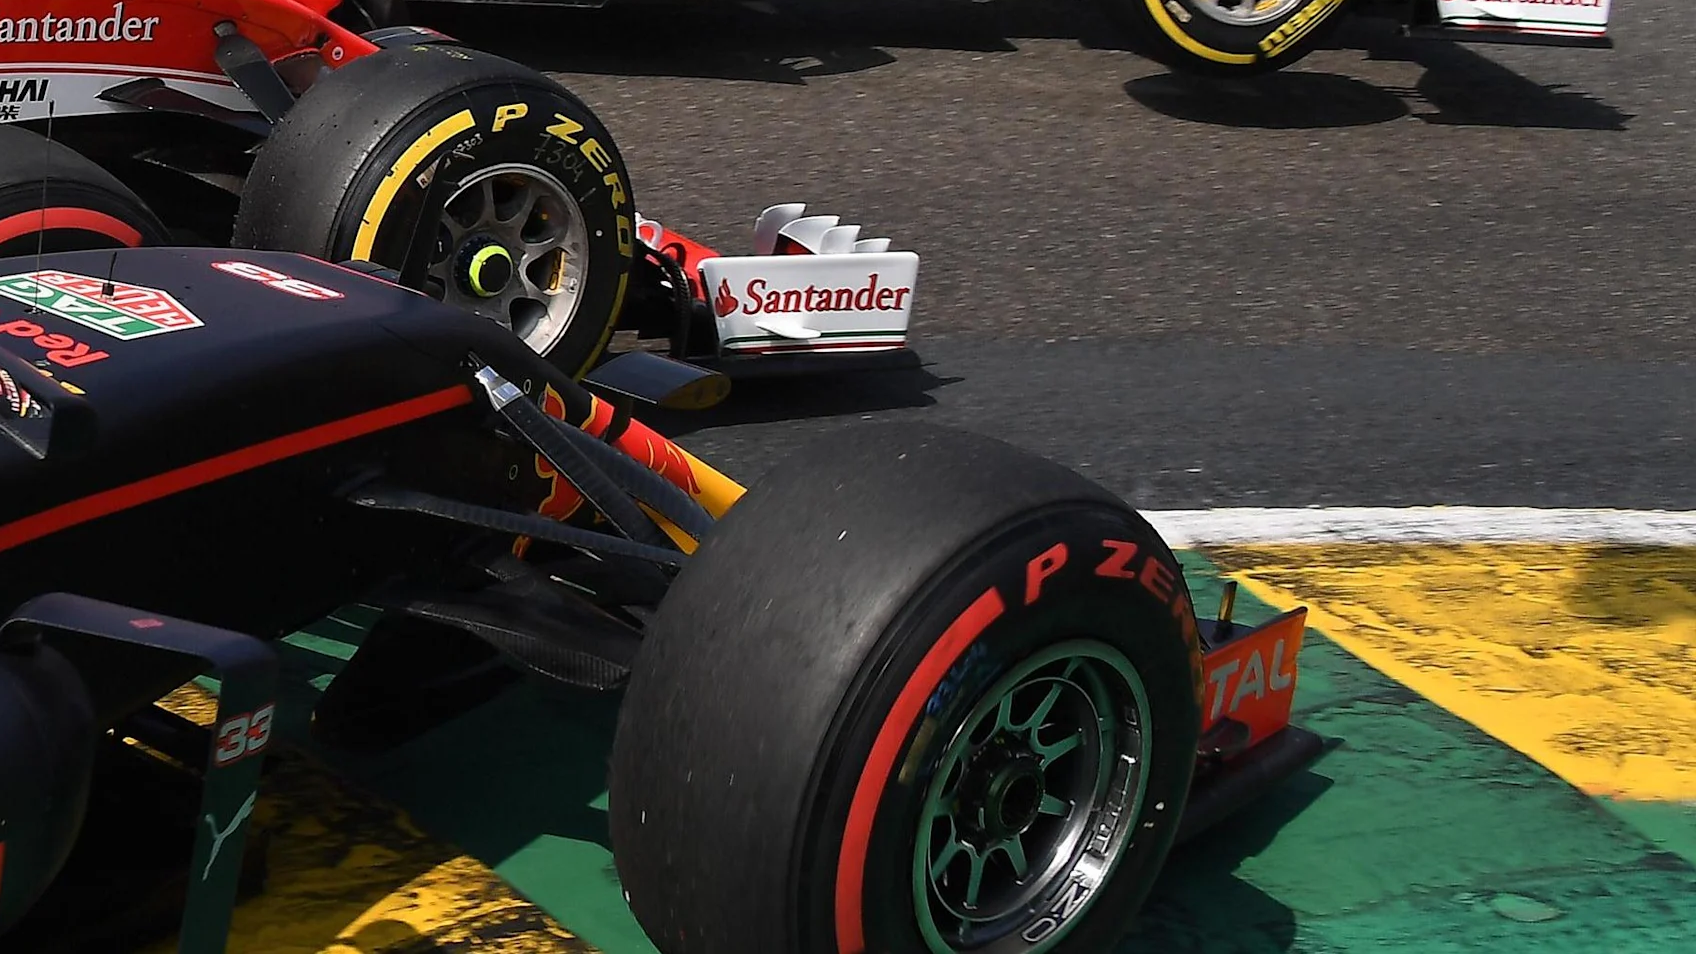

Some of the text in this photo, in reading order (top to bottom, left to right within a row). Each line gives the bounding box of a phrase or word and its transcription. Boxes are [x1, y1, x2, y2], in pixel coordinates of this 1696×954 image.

[546, 113, 633, 258] ZERO
[40, 273, 190, 328] HEUER
[742, 273, 910, 315] Santander
[1210, 638, 1292, 721] TAL
[215, 702, 275, 767] 33
